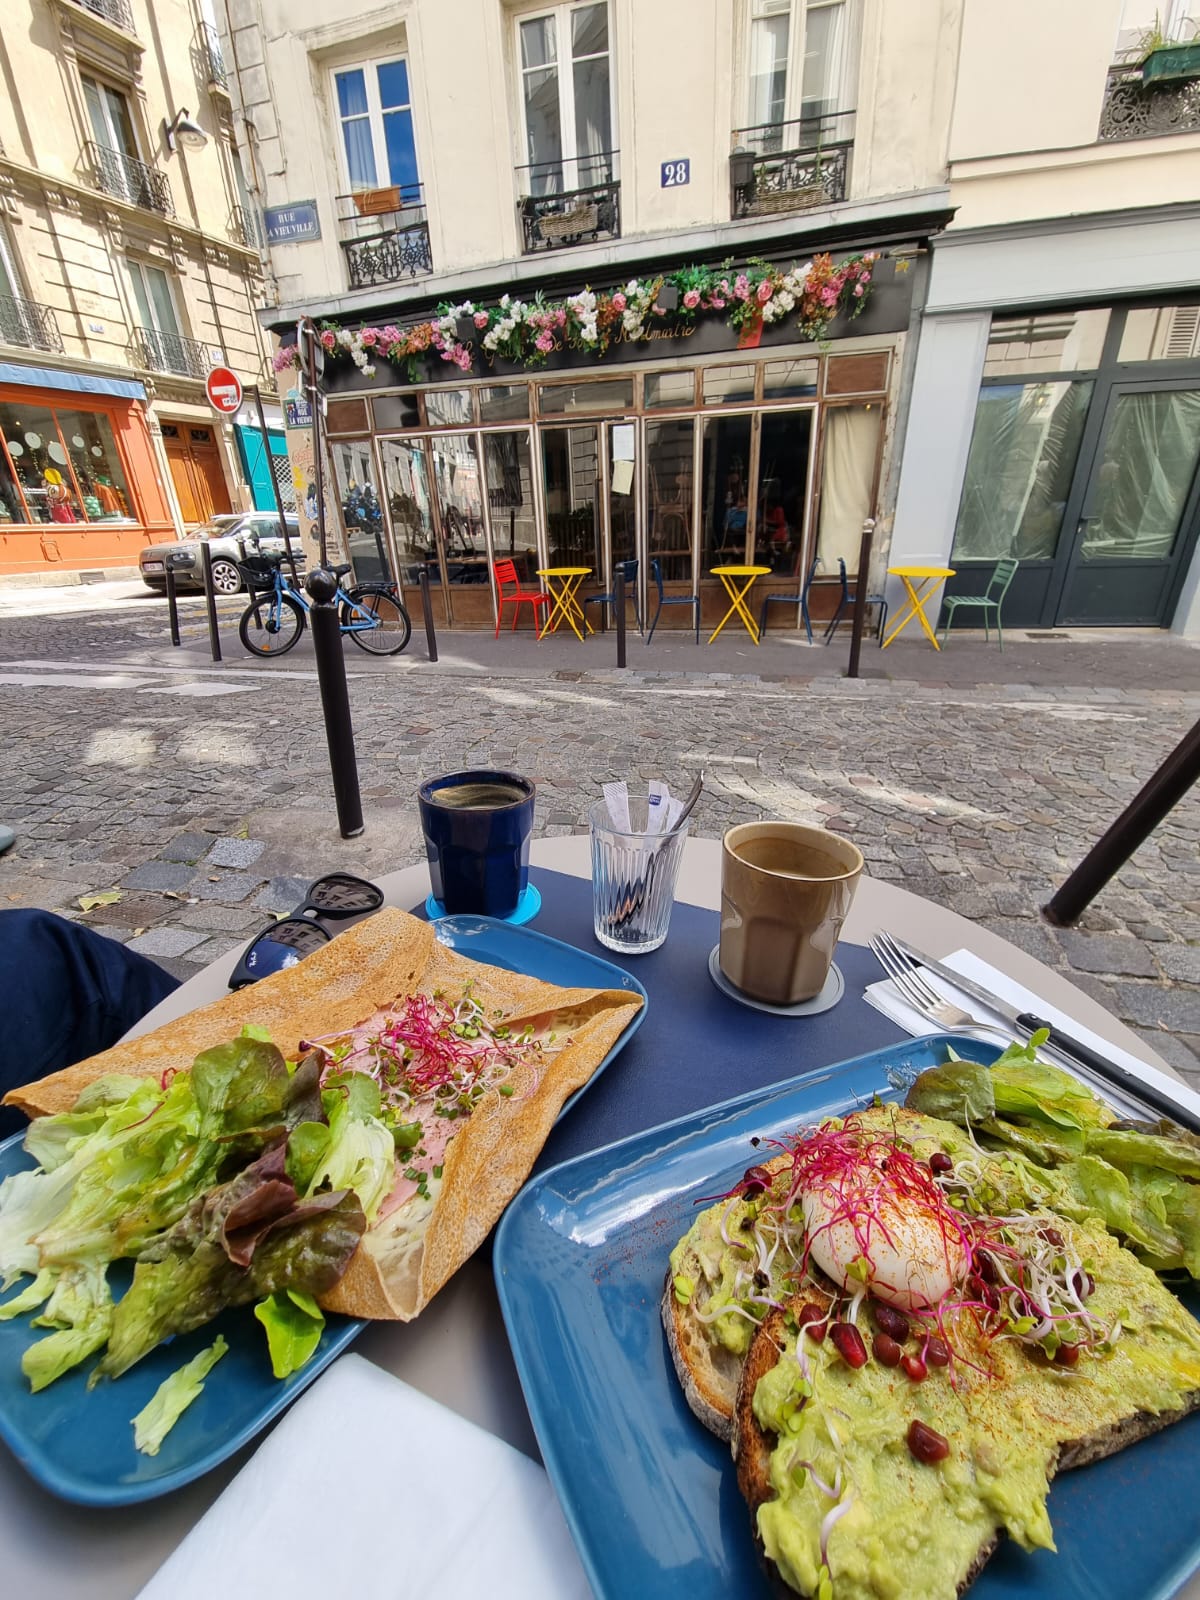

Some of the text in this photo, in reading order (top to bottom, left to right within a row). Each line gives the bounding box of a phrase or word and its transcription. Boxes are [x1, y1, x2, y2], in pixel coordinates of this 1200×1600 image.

[665, 162, 686, 186] 28
[277, 211, 295, 223] RUE
[274, 221, 314, 237] VIEUVILLE
